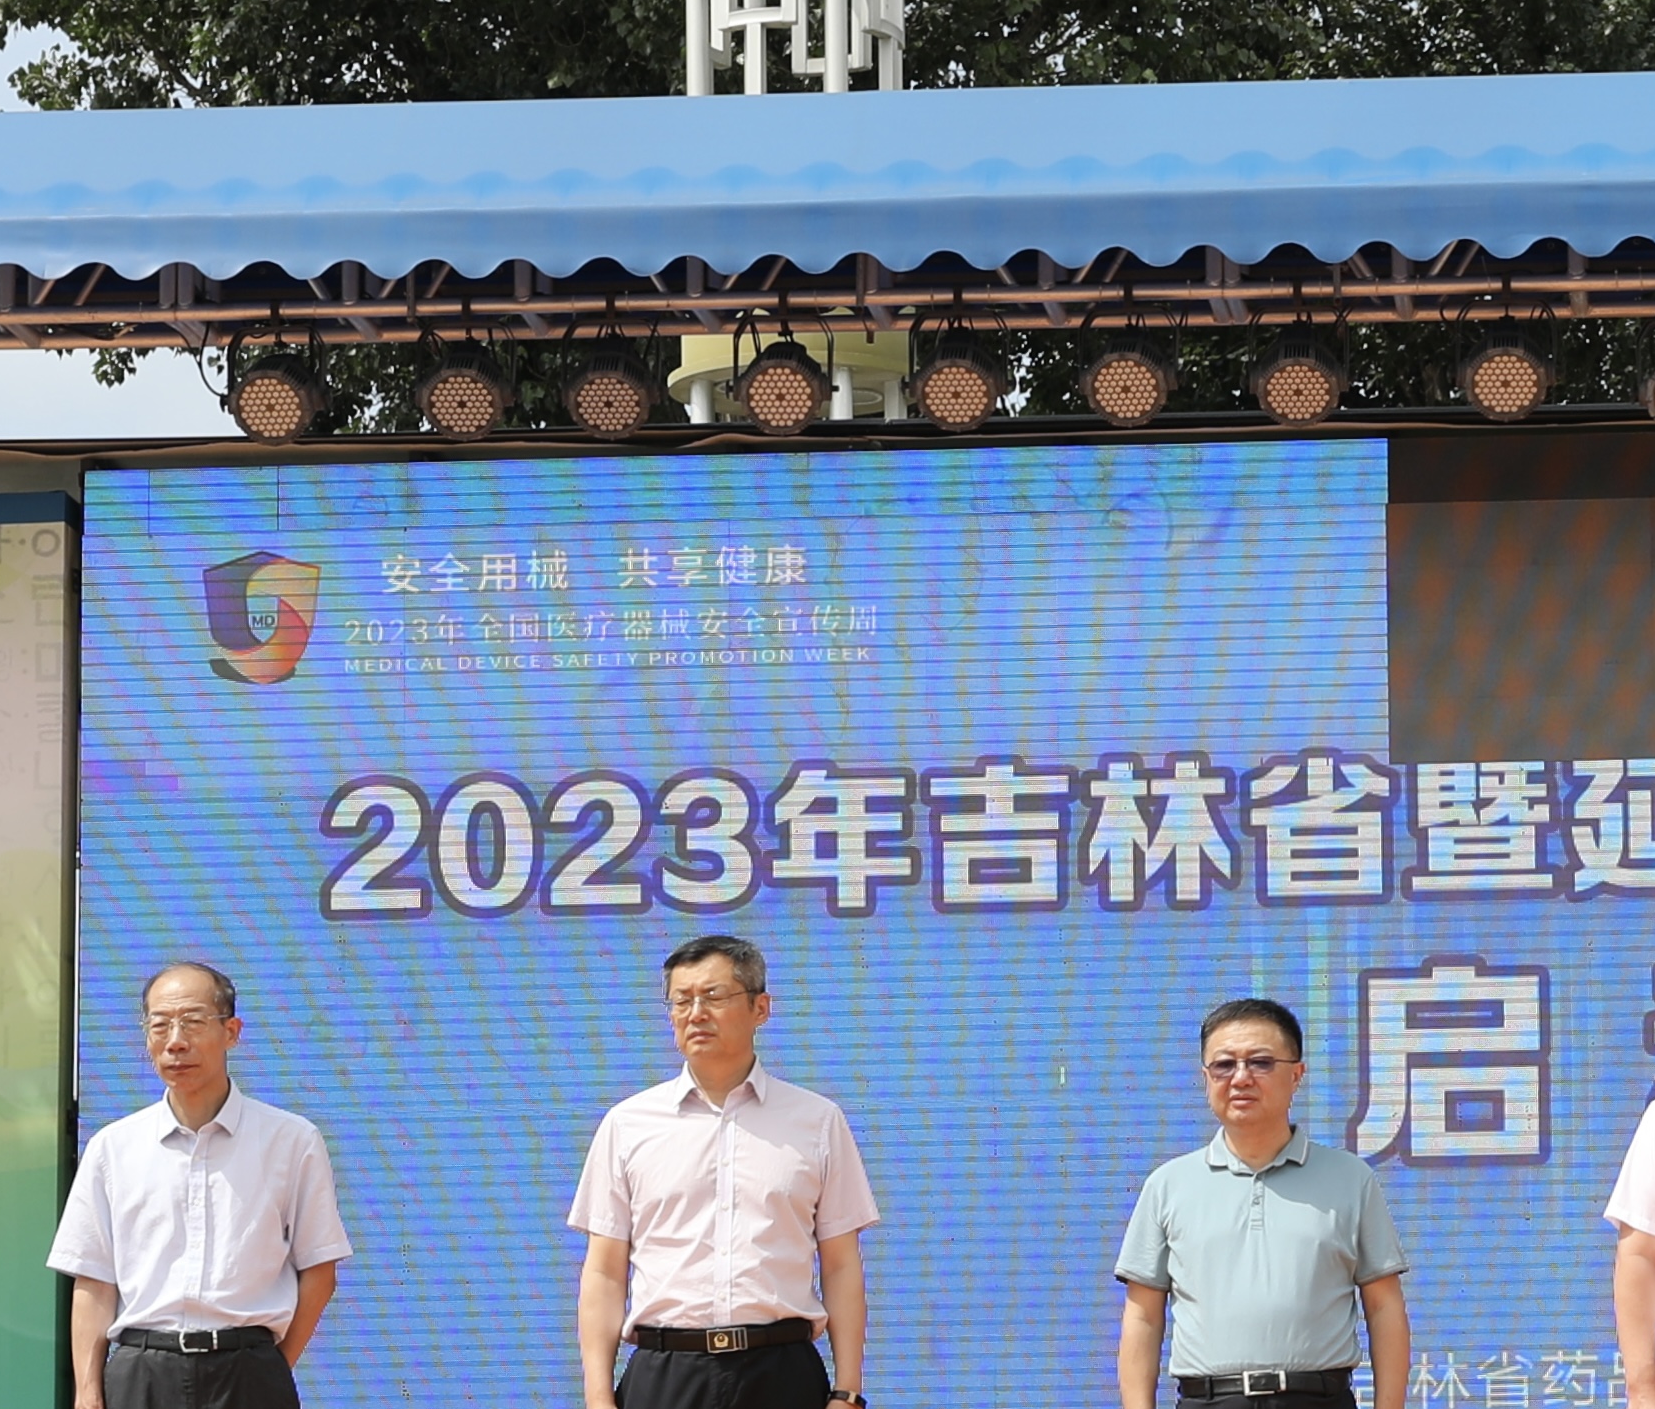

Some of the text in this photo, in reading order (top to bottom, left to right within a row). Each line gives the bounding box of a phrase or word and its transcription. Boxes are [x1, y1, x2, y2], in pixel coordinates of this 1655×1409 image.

[381, 543, 808, 593] 安全用械 共享健康
[251, 613, 276, 629] MD
[345, 646, 872, 675] MEDICAL DEVICE SAFETY PROMOTION WEEK
